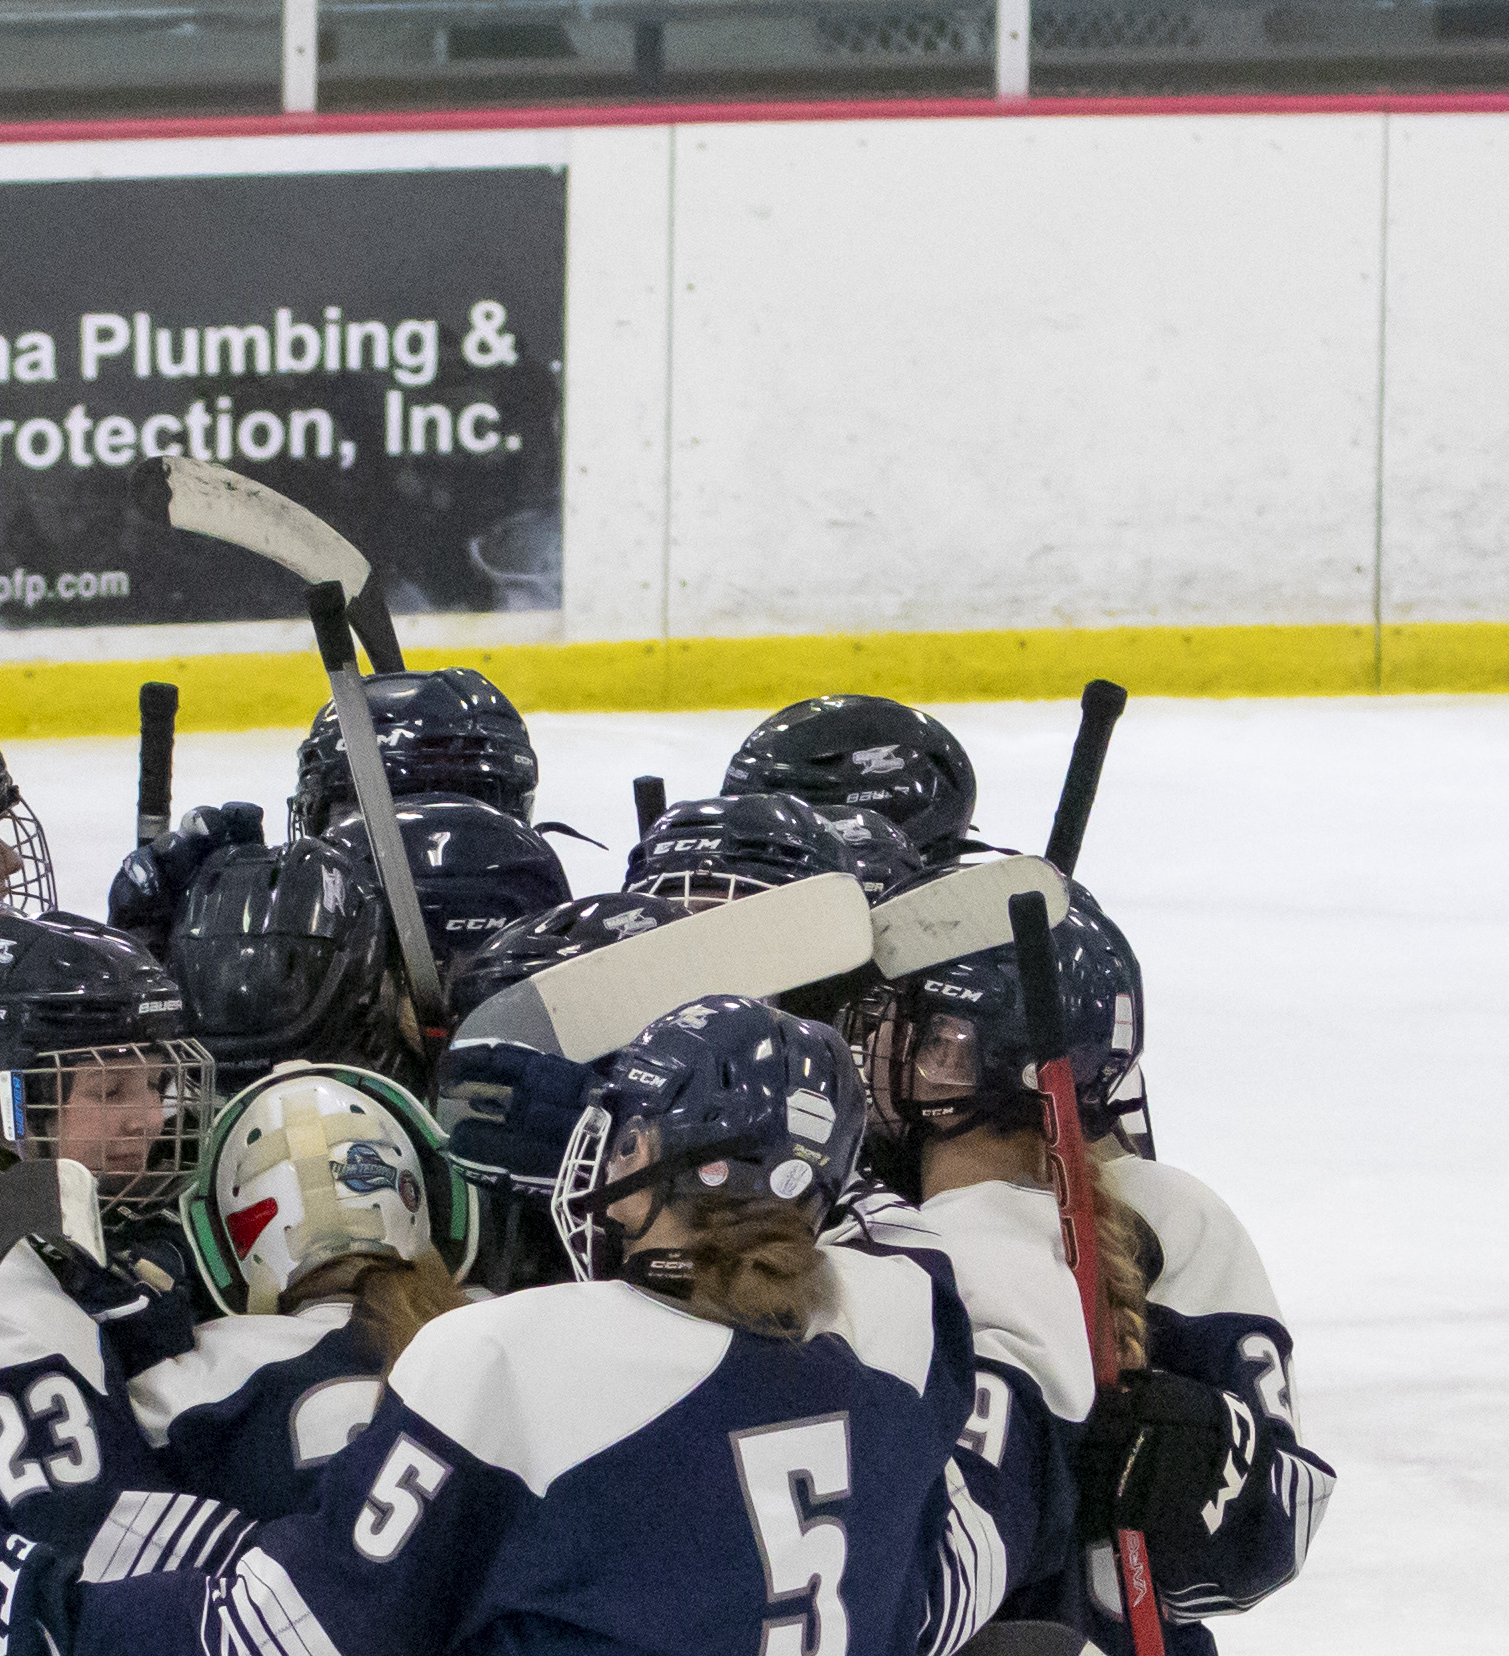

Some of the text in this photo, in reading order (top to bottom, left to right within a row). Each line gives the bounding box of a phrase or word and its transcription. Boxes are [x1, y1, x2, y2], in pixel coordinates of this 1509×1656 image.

[80, 305, 439, 387] Plumbing
[461, 300, 518, 368] &
[385, 388, 522, 456] Inc.
[653, 838, 722, 855] CCM
[445, 917, 507, 931] CCM
[924, 979, 984, 1003] CCM
[627, 1068, 667, 1088] CCM
[352, 1430, 455, 1564] 5
